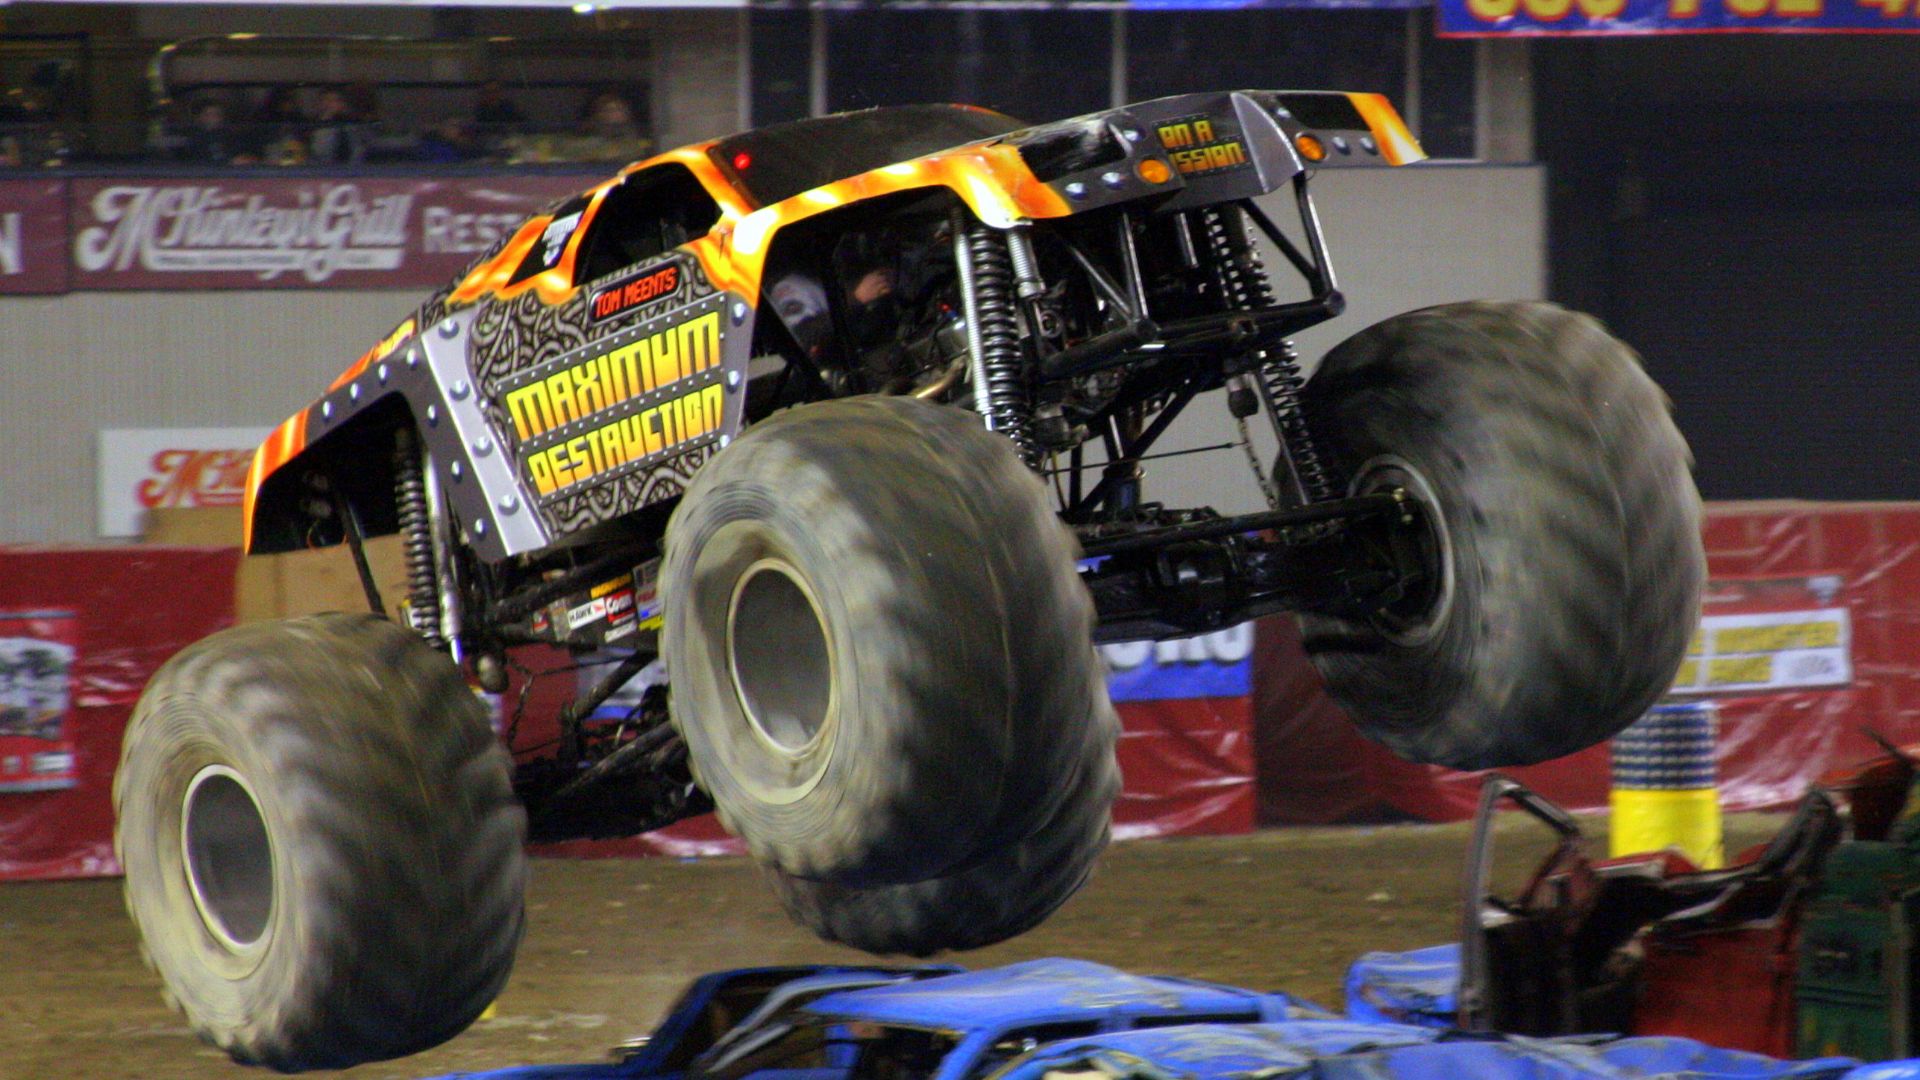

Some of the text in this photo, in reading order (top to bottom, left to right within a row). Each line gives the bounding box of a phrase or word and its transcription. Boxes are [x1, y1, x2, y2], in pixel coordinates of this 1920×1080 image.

[1158, 120, 1215, 149] ON A
[1168, 142, 1246, 174] ISSION
[596, 266, 679, 318] TOM MEENTS
[506, 311, 721, 442] MAXIMUM
[528, 383, 724, 497] DESTRUCTION
